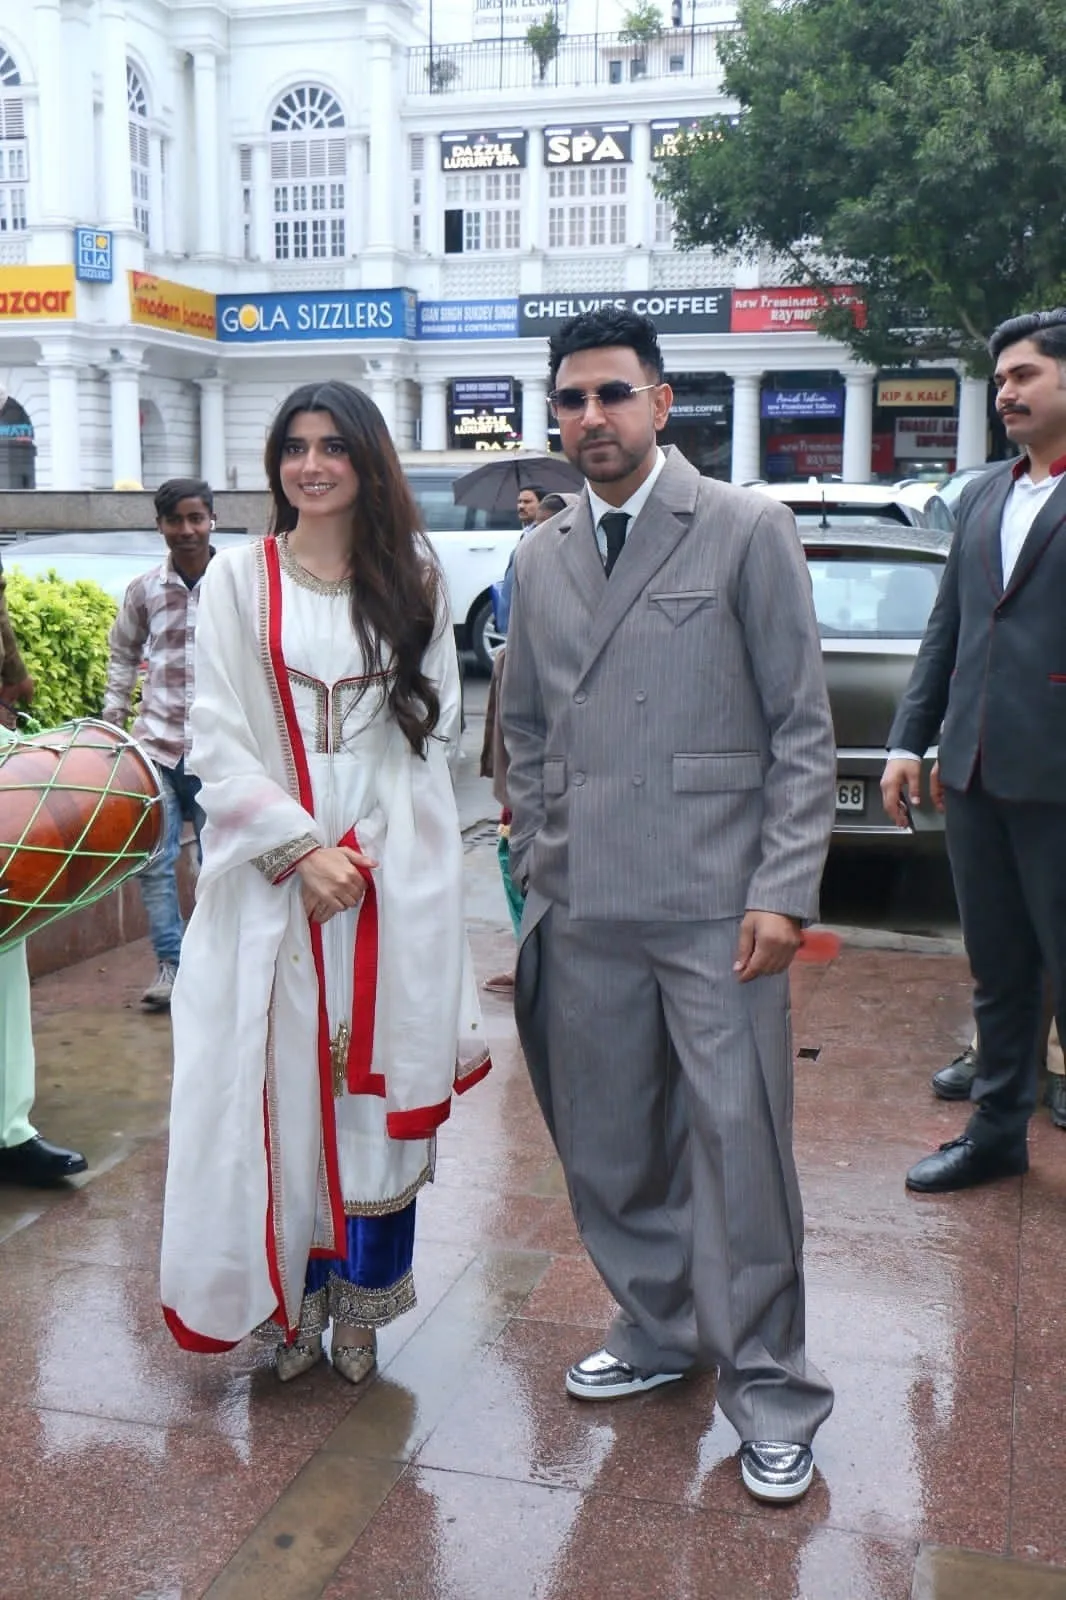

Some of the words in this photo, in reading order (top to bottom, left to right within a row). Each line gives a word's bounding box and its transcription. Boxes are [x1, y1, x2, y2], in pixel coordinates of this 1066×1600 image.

[452, 143, 513, 157] DAZZLE
[547, 135, 625, 163] SPA
[444, 155, 495, 169] LUXURY
[496, 154, 520, 167] SPA
[134, 296, 180, 321] modern
[633, 296, 719, 315] COFFEE
[760, 294, 818, 308] Prominent
[222, 304, 290, 332] GOLA
[298, 301, 393, 330] SIZZLERS
[881, 391, 901, 401] KIP
[904, 391, 913, 401] &
[917, 391, 948, 401] KALF
[461, 416, 507, 426] DAZZLE
[838, 784, 861, 805] 68
